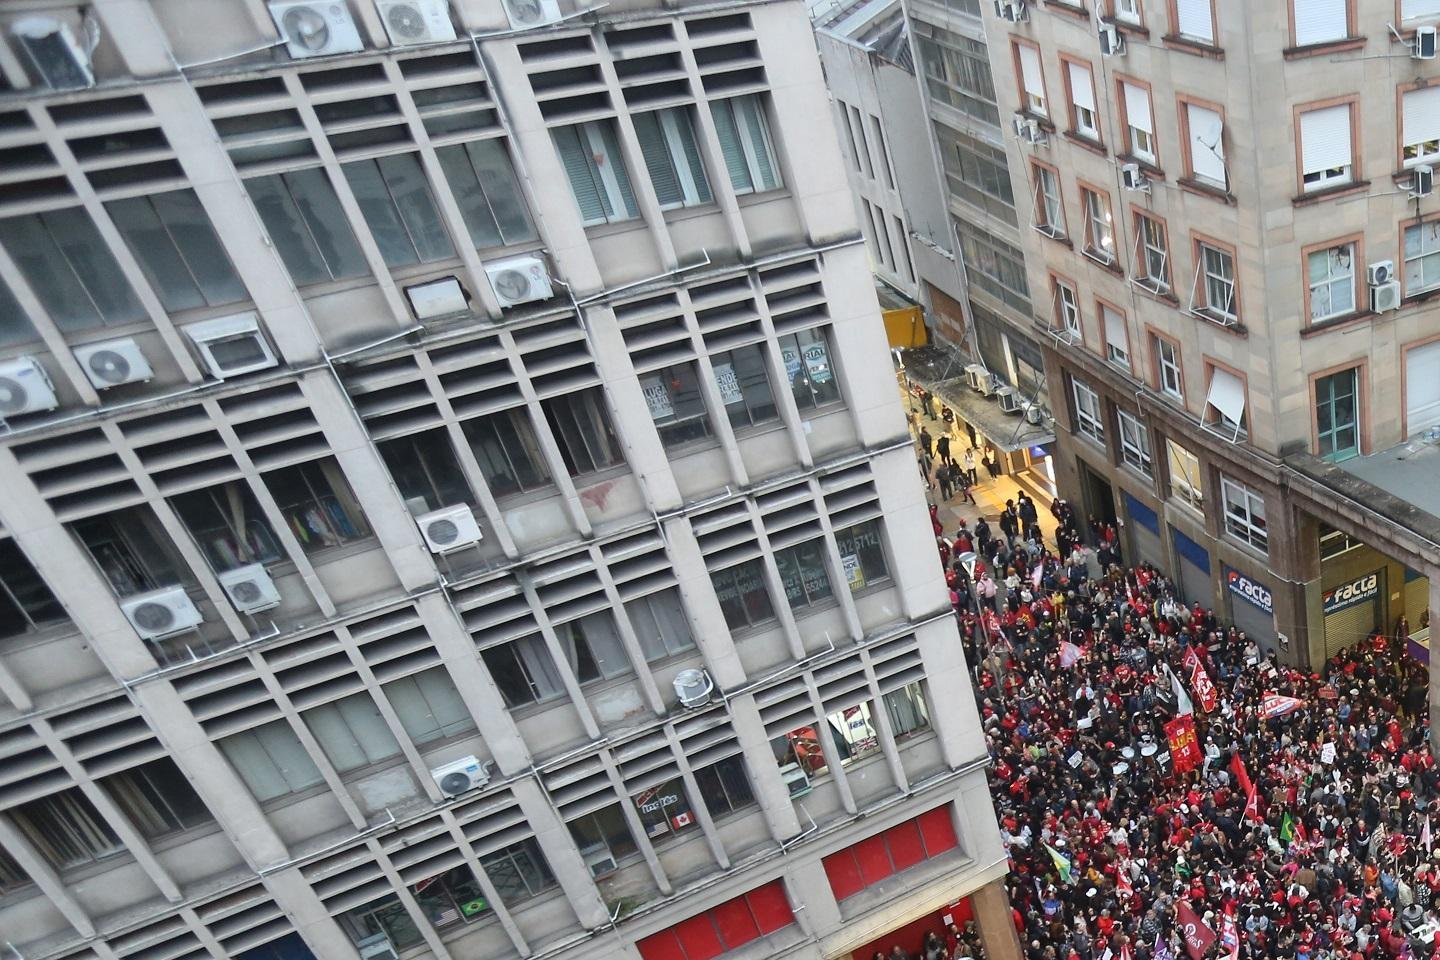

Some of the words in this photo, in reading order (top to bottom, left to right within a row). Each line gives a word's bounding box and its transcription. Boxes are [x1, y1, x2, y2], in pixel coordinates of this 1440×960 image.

[1239, 577, 1272, 607] facta
[1334, 574, 1377, 604] facta
[642, 794, 678, 814] Inglês
